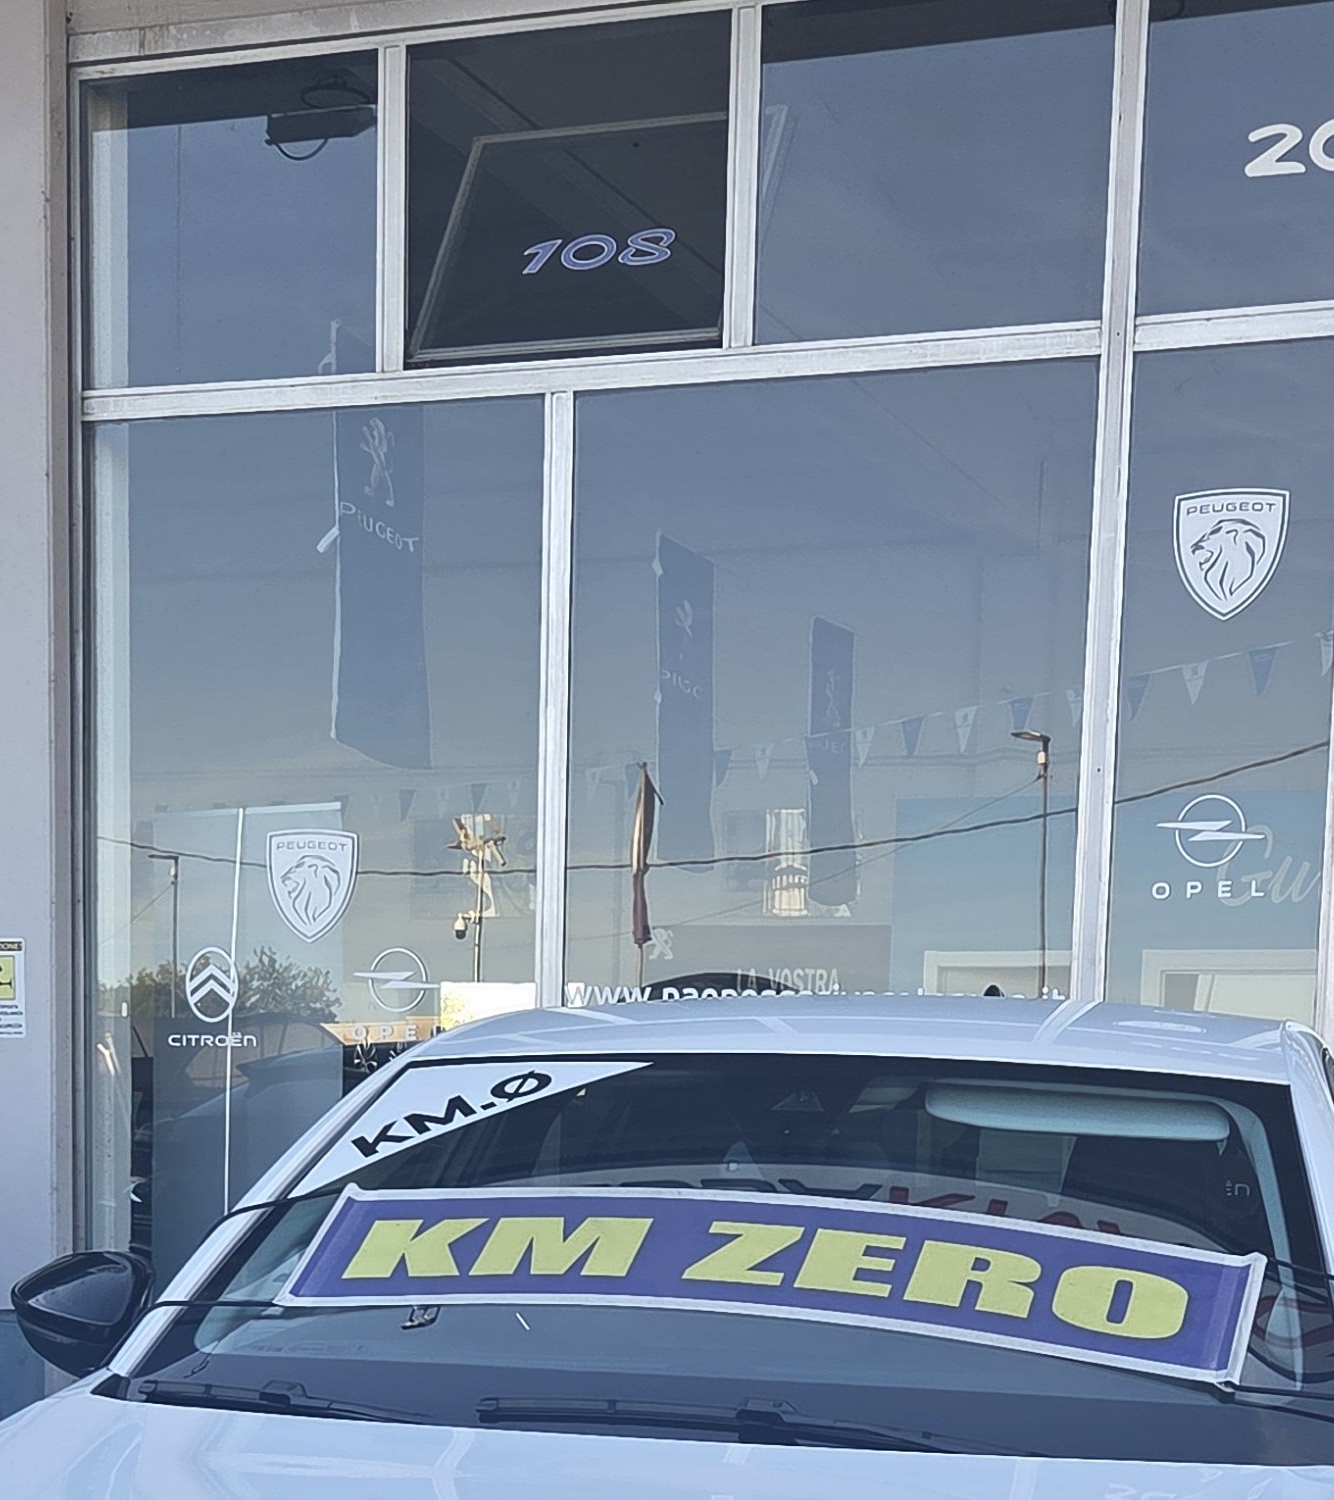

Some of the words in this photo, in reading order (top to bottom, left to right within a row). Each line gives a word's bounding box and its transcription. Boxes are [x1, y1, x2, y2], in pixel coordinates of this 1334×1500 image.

[522, 227, 677, 275] 108
[1186, 500, 1277, 517] PEUGEOT
[276, 841, 348, 852] PEUGEOT
[1151, 880, 1265, 899] OPEL
[341, 1216, 655, 1280] KM
[682, 1221, 1191, 1341] ZERO
